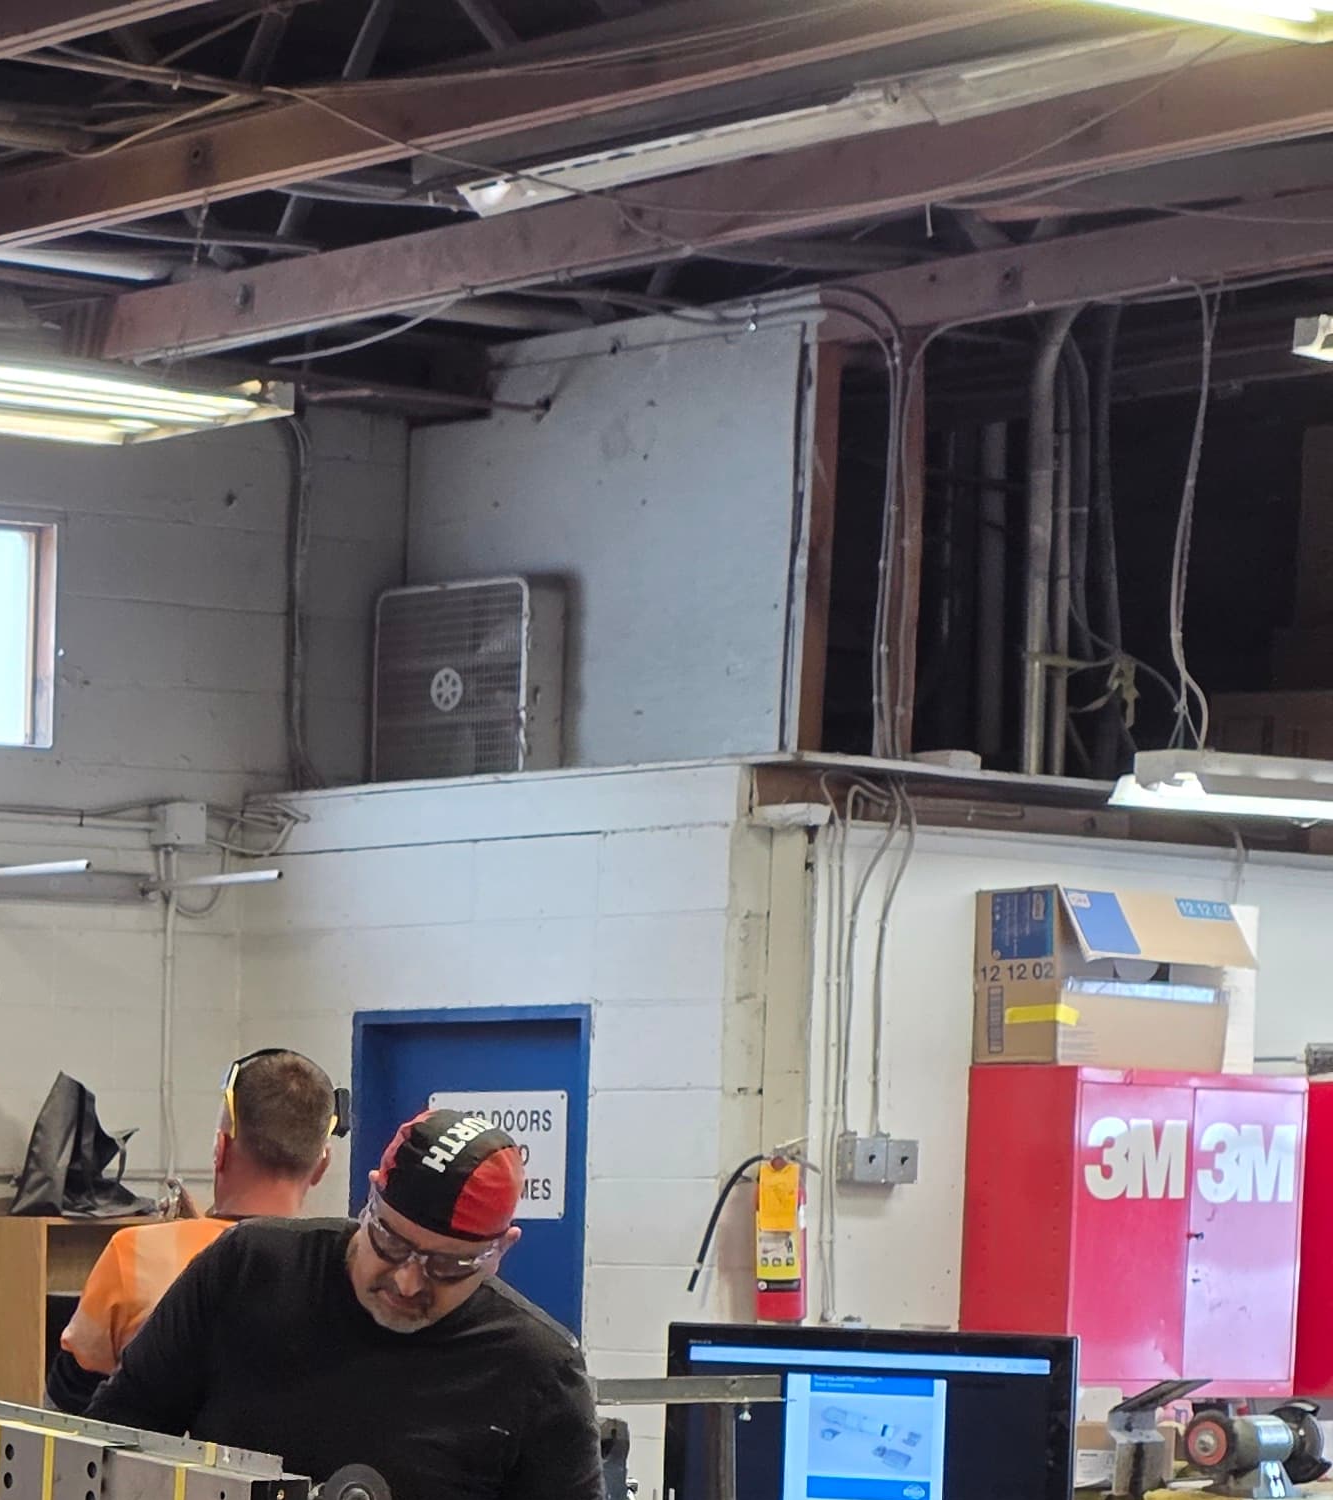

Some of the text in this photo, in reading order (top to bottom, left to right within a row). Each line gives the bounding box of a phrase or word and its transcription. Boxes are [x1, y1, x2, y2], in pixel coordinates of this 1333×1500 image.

[981, 962, 1054, 981] 12 12 02
[491, 1109, 552, 1132] DOORS
[1084, 1117, 1188, 1200] 3M
[1197, 1123, 1298, 1203] 3M
[520, 1178, 551, 1200] MES
